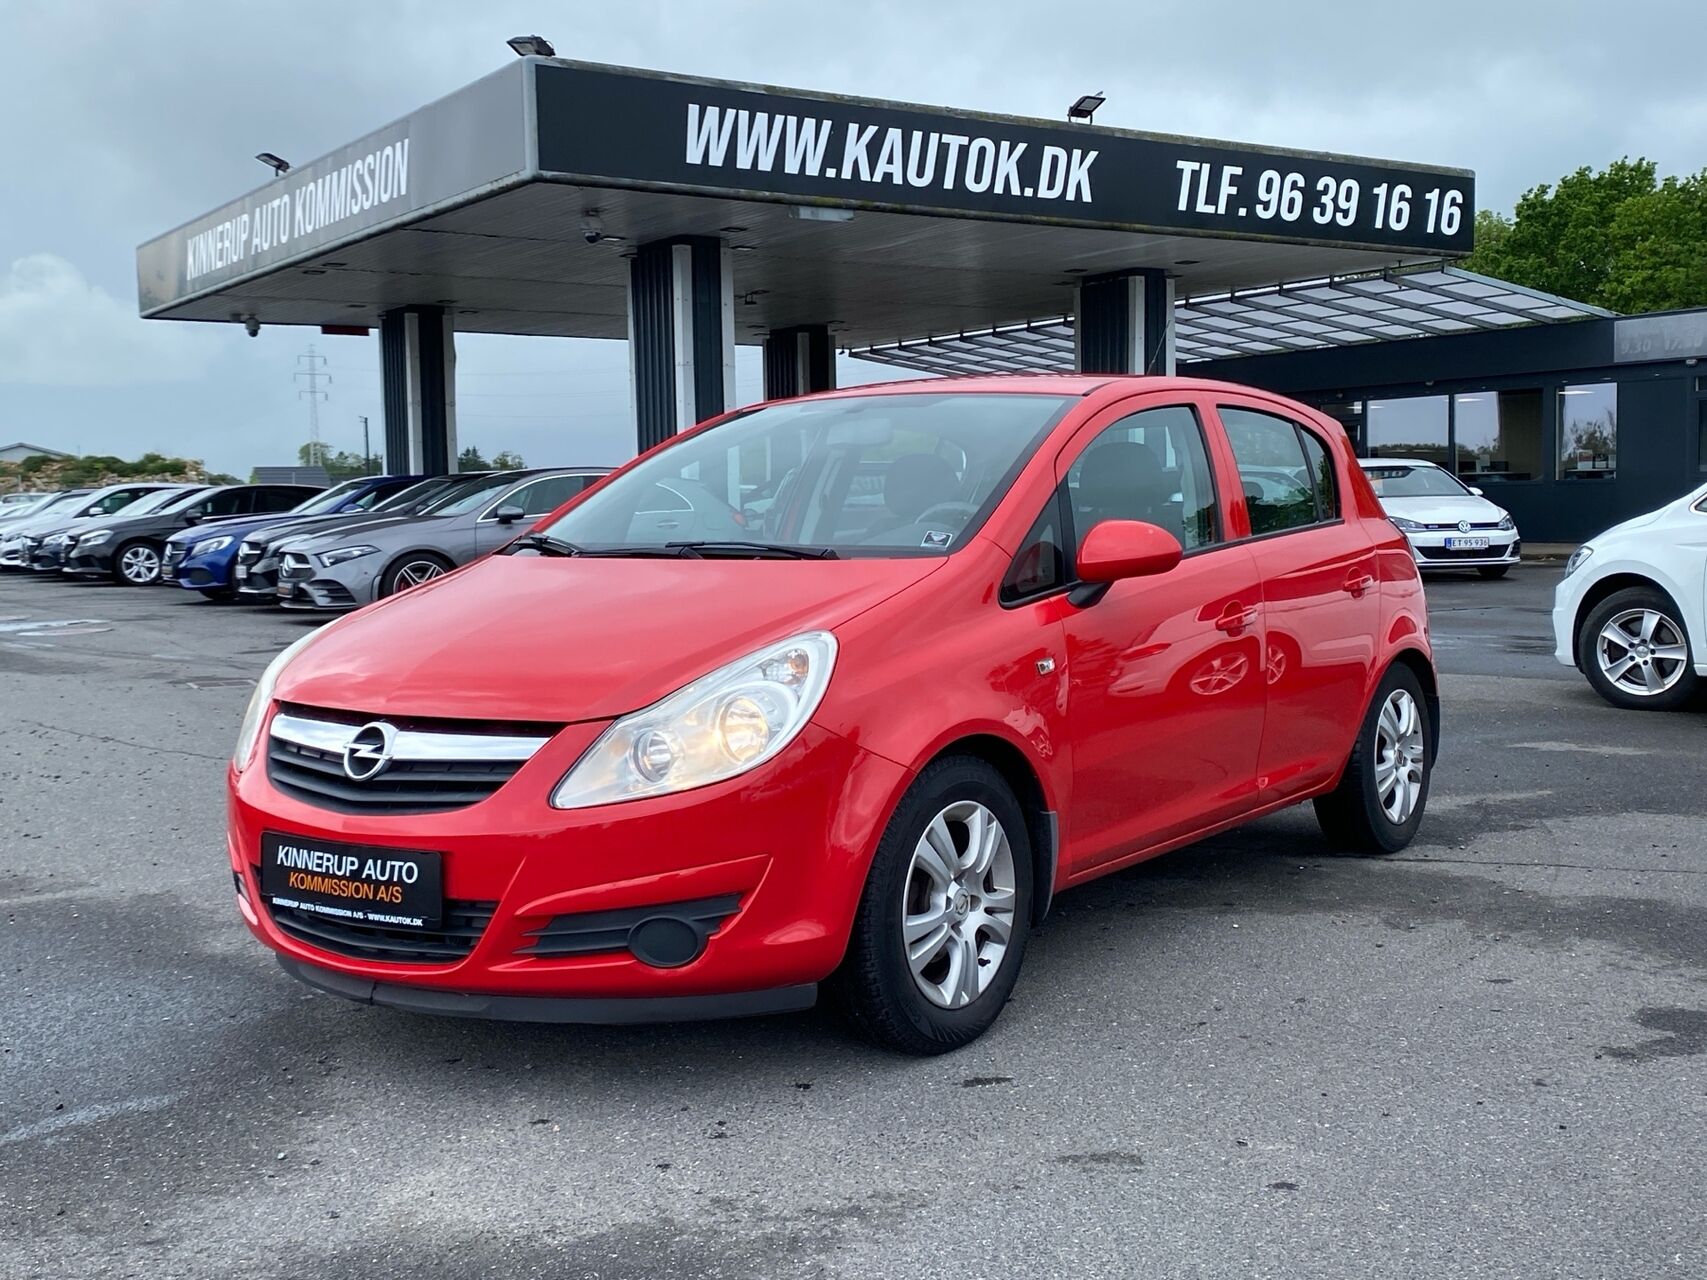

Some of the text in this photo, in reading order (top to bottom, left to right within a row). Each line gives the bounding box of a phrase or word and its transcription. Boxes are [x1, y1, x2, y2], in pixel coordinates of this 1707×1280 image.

[685, 103, 1098, 203] WWW.KAUTOK.DK
[186, 138, 409, 281] KINNERUP AUTO KOMMISSION
[1176, 159, 1464, 237] TLF. 96 39 16 16
[1464, 538, 1473, 547] 95
[277, 845, 418, 884] KINNERUP AUTO
[289, 871, 402, 904] KOMMISSION A/S
[272, 896, 299, 908] KINNERUP
[299, 902, 315, 912] AUTO
[315, 904, 352, 918] KOMMISSION
[352, 910, 364, 919] A/S
[368, 912, 424, 927] WWW.KAUTOK.DK
